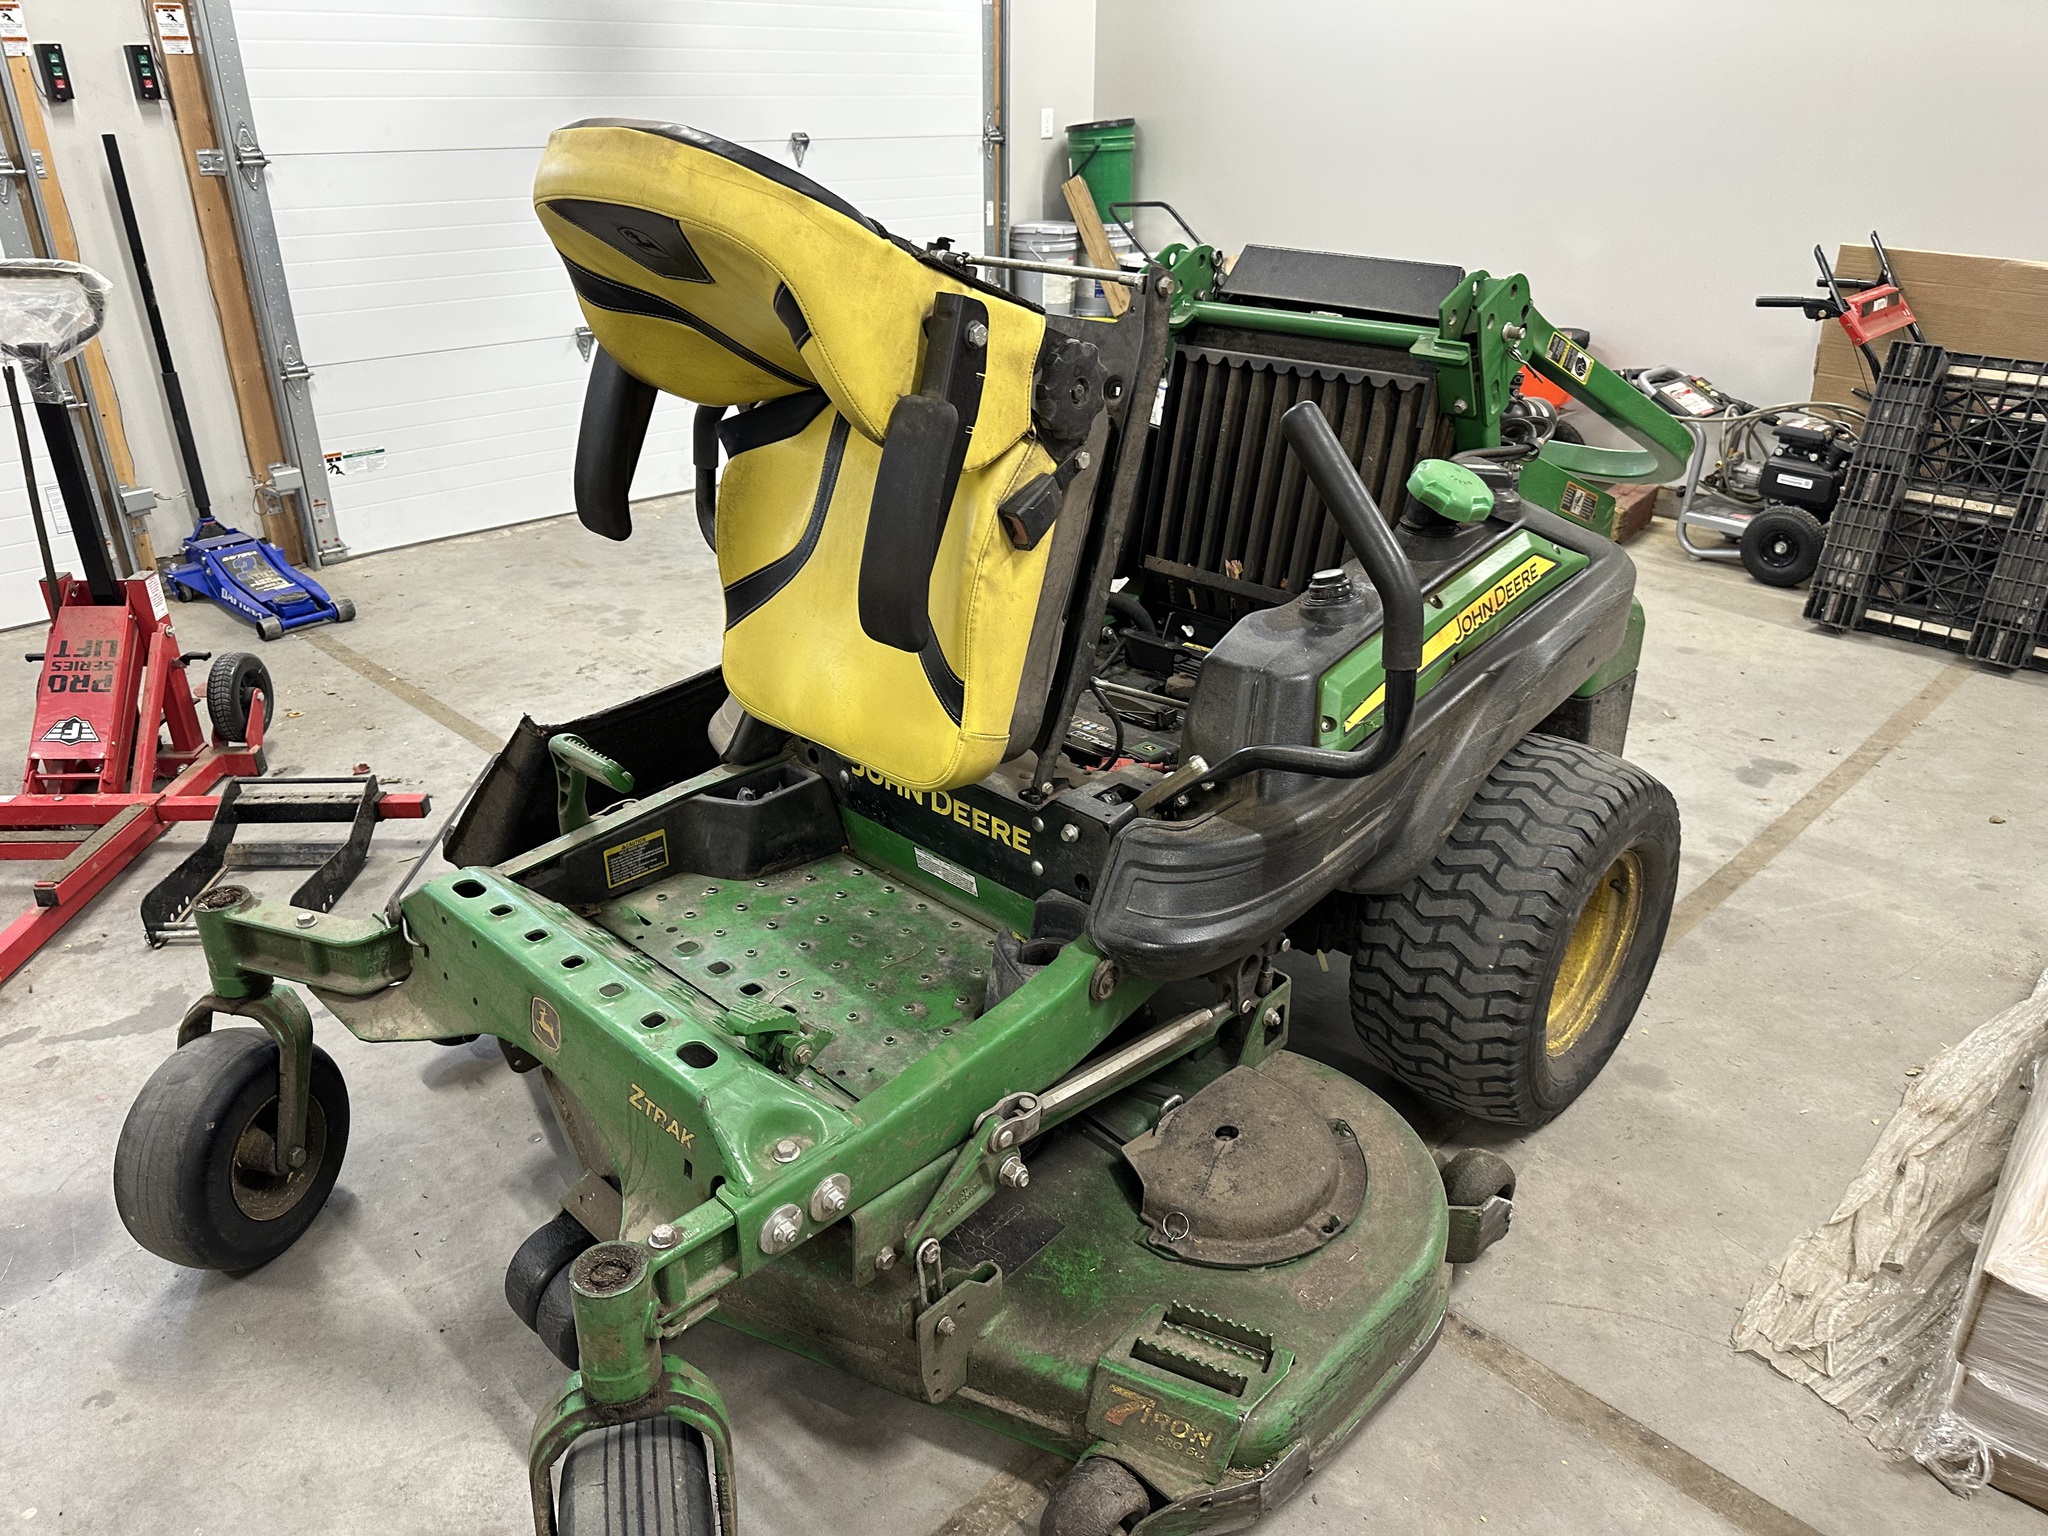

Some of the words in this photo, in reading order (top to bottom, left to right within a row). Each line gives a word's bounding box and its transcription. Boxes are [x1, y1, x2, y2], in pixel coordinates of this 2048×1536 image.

[1455, 598, 1494, 641] JOHN
[1494, 562, 1540, 608] DEERE
[53, 640, 118, 657] LIFT
[51, 661, 115, 671] SERIES
[47, 674, 113, 693] PRO
[931, 789, 1031, 855] DEERE
[628, 1083, 696, 1151] ZTRAK
[1155, 1434, 1183, 1450] PRO
